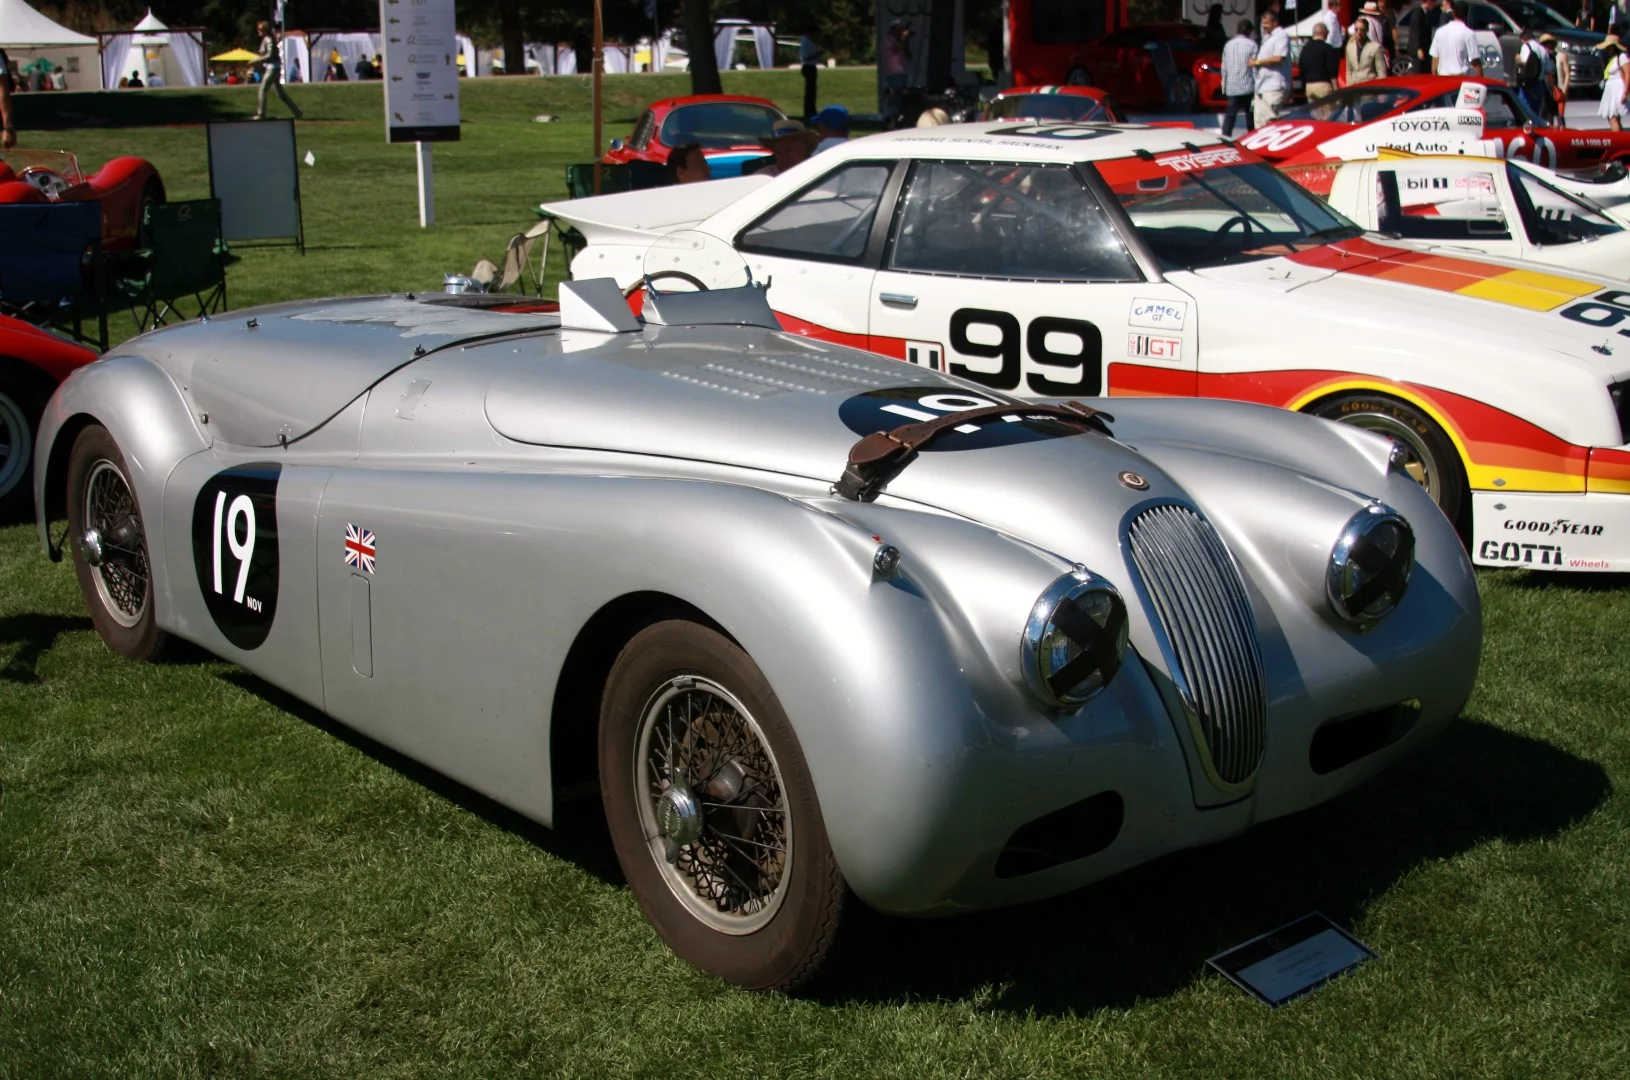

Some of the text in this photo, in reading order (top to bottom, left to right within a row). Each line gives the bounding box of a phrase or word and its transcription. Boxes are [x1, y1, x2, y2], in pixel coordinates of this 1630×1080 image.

[1390, 121, 1450, 133] TOYOTA
[998, 140, 1063, 151] HACKMAN
[1240, 124, 1314, 151] 160
[1365, 142, 1448, 153] Uted Auto
[1155, 148, 1243, 172] TOYSPORT
[1134, 304, 1182, 321] CAMEL
[1152, 313, 1164, 322] GT
[949, 307, 1102, 397] 99
[1150, 339, 1180, 357] GT
[213, 490, 256, 604] 19
[1569, 559, 1609, 569] Wheels
[247, 596, 262, 613] NOV
